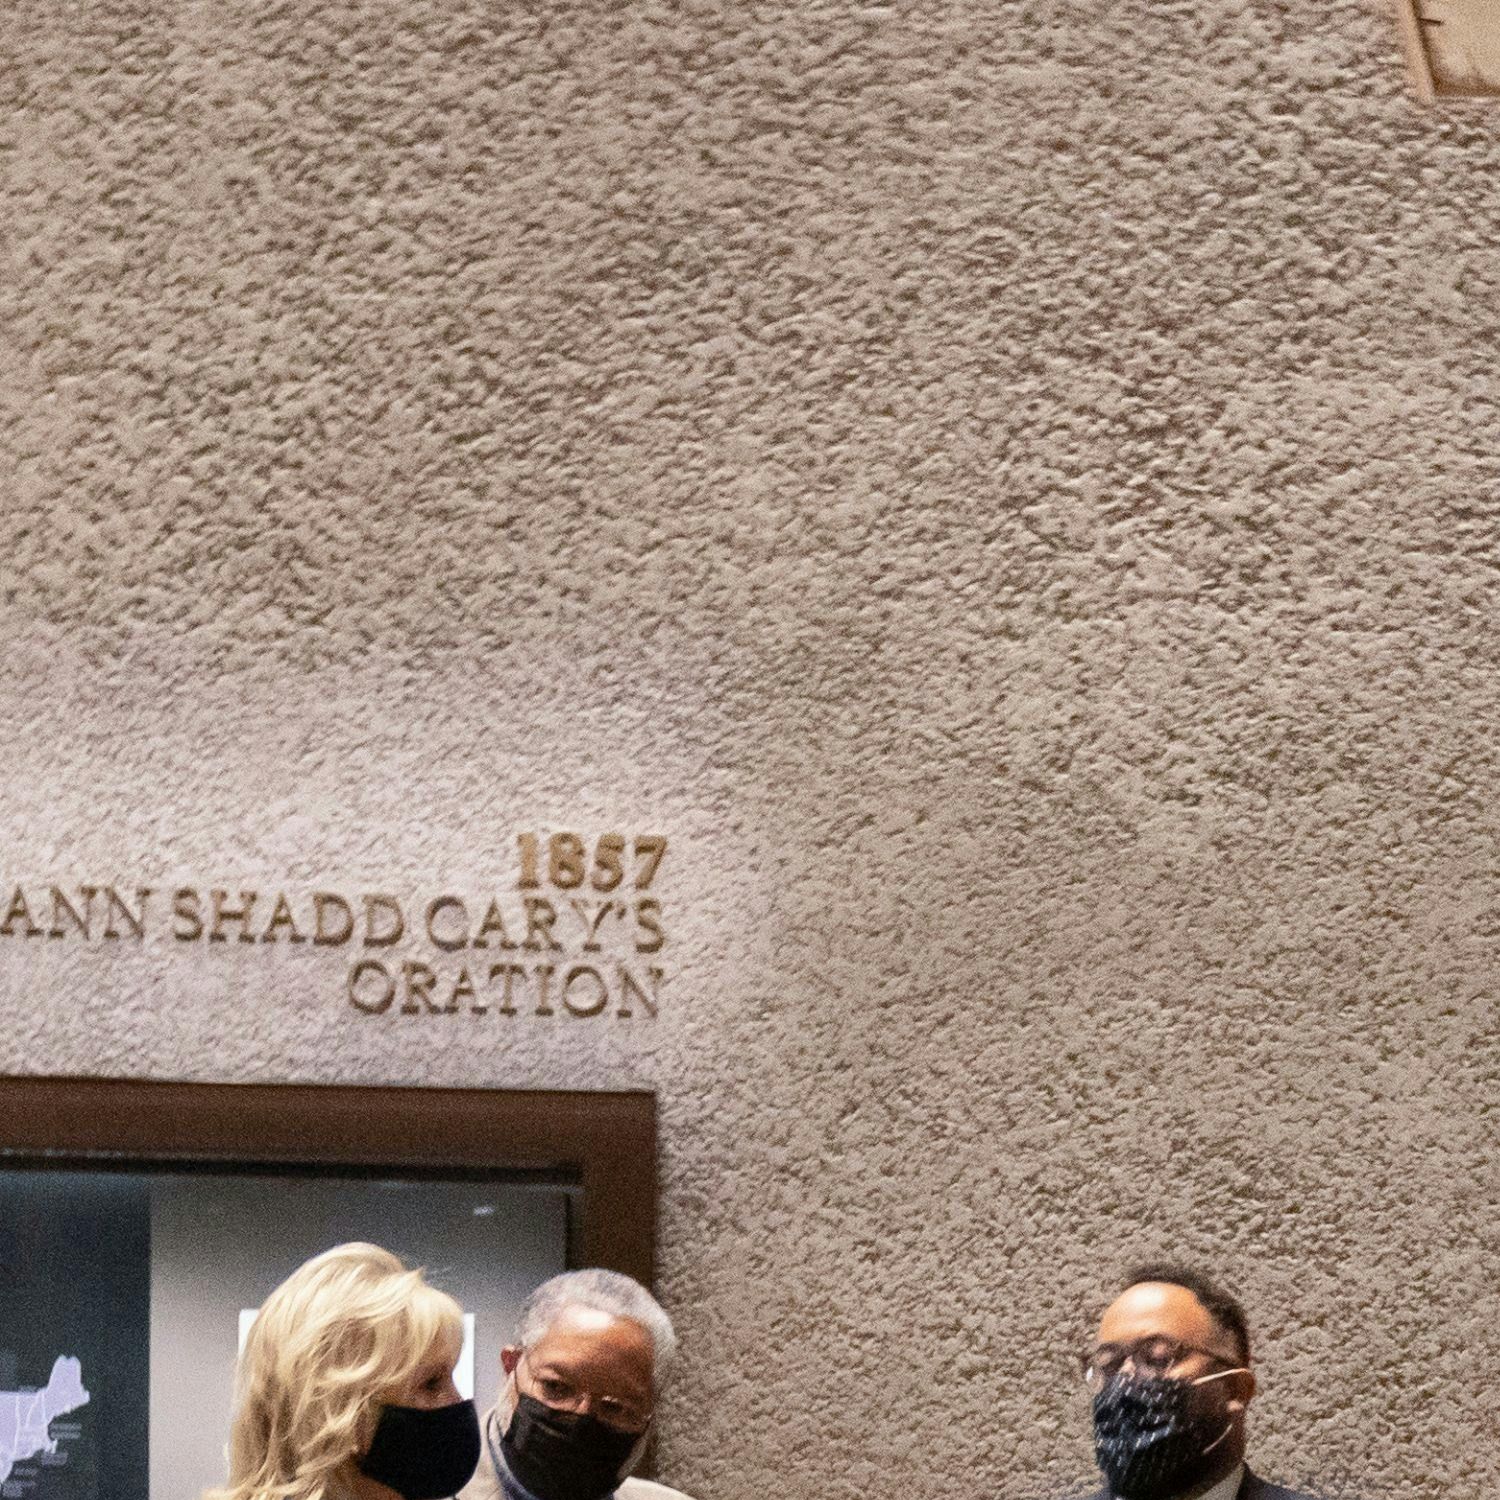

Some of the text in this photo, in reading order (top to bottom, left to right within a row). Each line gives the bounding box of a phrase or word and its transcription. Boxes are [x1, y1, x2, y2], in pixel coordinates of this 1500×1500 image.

[516, 832, 668, 893] 1857
[0, 884, 666, 953] ANN SHADD CARY'S
[350, 959, 665, 1020] ORATION
